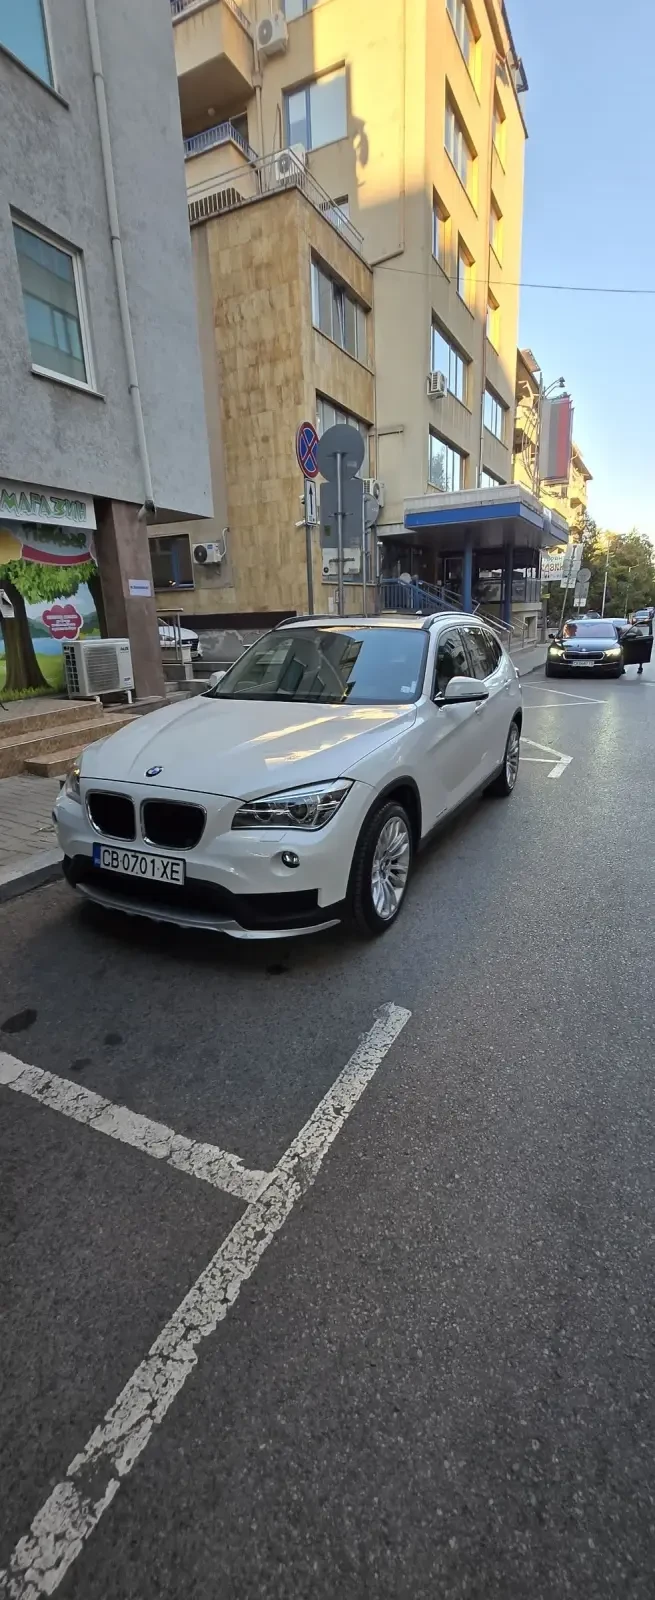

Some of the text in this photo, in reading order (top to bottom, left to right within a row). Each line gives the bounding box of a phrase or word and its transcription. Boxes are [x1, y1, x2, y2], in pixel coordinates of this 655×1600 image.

[0, 488, 87, 522] МАГАЗИН
[102, 849, 181, 882] CB 0701 XE
